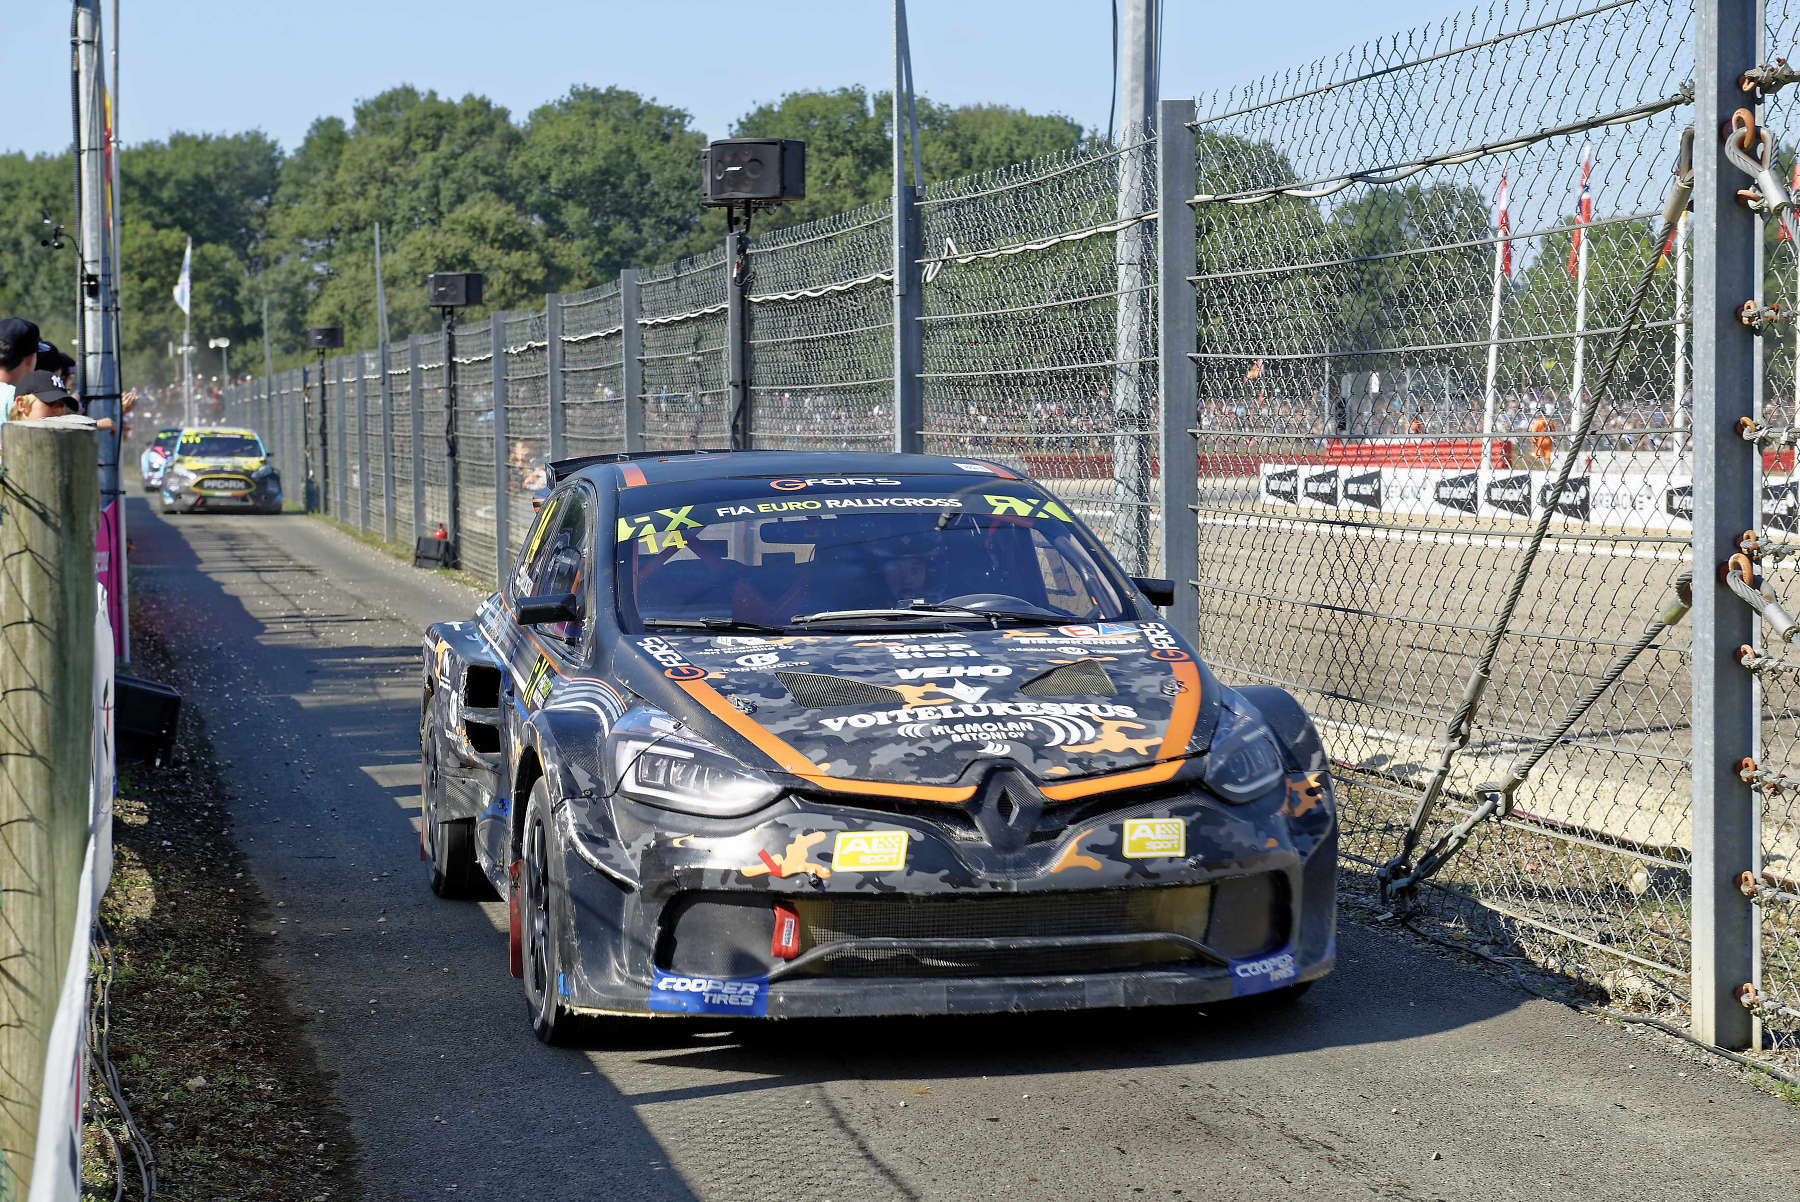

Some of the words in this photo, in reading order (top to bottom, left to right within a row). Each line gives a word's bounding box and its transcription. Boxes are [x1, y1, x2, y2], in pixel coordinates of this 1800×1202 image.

[716, 505, 755, 517] FIA
[757, 500, 822, 513] EURO
[825, 497, 963, 510] RALLYCROSS
[638, 530, 688, 554] 14
[895, 665, 1013, 680] VEHO
[818, 702, 1138, 732] VOITELUKESKUS
[931, 721, 1034, 736] KLEMOLAN
[951, 732, 1002, 743] BETONI
[658, 977, 760, 996] COOPER
[702, 991, 756, 1006] TIRES
